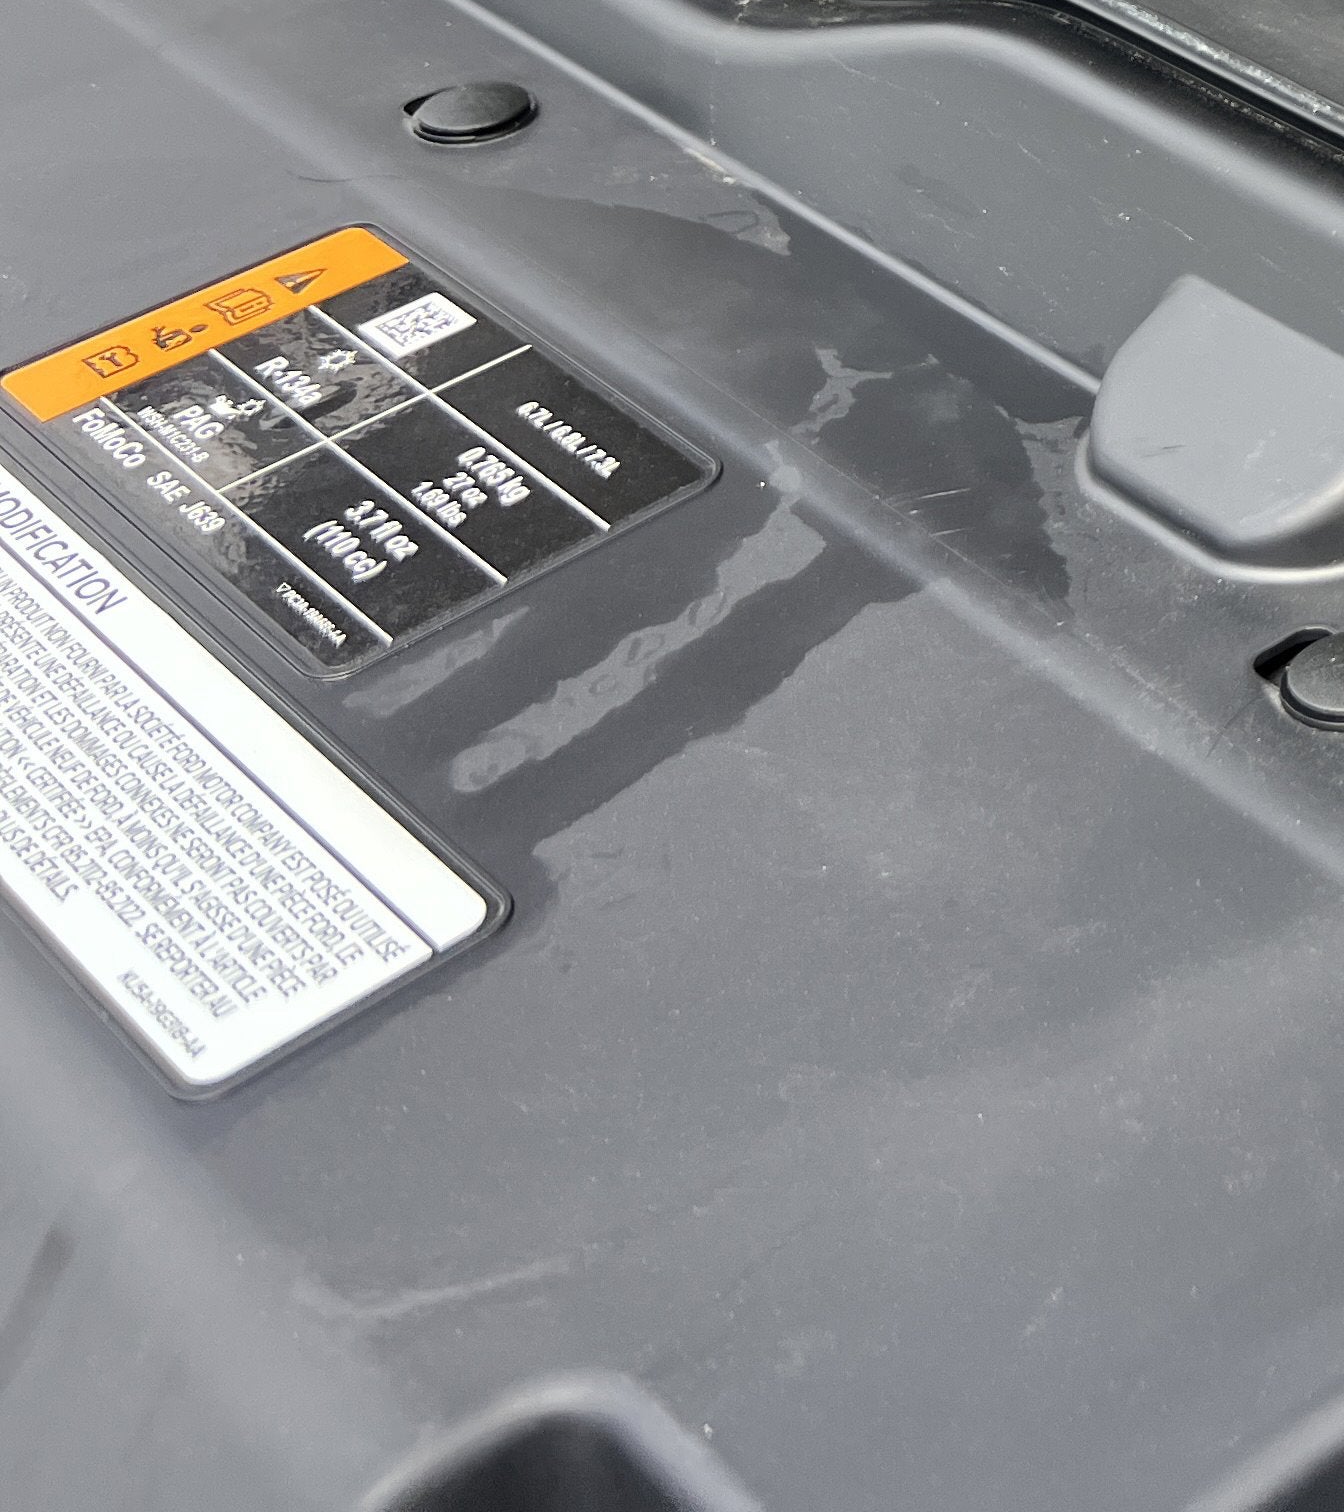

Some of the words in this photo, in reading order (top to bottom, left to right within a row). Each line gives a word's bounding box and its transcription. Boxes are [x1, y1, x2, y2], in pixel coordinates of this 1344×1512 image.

[256, 357, 322, 406] R-134a
[172, 405, 224, 440] PAG
[73, 409, 145, 468] FoMoCo
[147, 471, 190, 502] SAE
[179, 502, 225, 533] J639
[443, 472, 475, 491] 27
[461, 487, 487, 507] oz
[458, 447, 514, 486] 0.765
[497, 476, 530, 506] kg
[411, 481, 450, 509] 1.69
[436, 501, 466, 527] lbs
[0, 491, 126, 613] ODIFICATION
[304, 521, 360, 557] (110
[343, 551, 387, 582] cc)
[345, 500, 388, 528] 3.7
[384, 535, 418, 560] oz
[0, 645, 45, 696] ARATION
[30, 689, 59, 708] ET
[42, 702, 75, 726] LES
[3, 701, 60, 751] VÉHICULE
[60, 719, 128, 778] DOMMAGES
[3, 587, 55, 627] PRODUIT
[41, 622, 74, 649] NON
[61, 642, 109, 680] FOURNI
[94, 673, 128, 699] PAR
[113, 692, 140, 712] LA
[127, 705, 184, 749] SOCIÉTÉ
[166, 742, 207, 774] FORD
[193, 767, 244, 809] MOTOR
[231, 803, 295, 856] COMPANY
[280, 850, 317, 876] EST
[302, 870, 350, 906] POSÉ
[331, 898, 364, 922] OU
[33, 653, 67, 679] UNE
[52, 672, 126, 736] DÉFAILLANCE
[112, 730, 141, 750] OU
[127, 744, 174, 782] CAUSE
[158, 774, 186, 795] LA
[172, 788, 253, 859] DÉFAILLANCE
[238, 851, 286, 891] D'UNE
[44, 744, 86, 774] NEUF
[69, 769, 99, 791] DE
[83, 783, 124, 820] FORD,
[114, 772, 180, 829] CONNEXES
[9, 836, 40, 858] DE
[26, 766, 86, 819] CERTIFIÉE
[108, 849, 205, 937] CONFORMÉMENT
[122, 820, 168, 859] MOINS
[165, 821, 195, 844] NE
[0, 767, 56, 831] ÈGLEMENTS
[41, 825, 75, 851] CFR
[134, 922, 165, 945] SE
[150, 937, 219, 1001] REPORTER
[180, 837, 237, 882] SERONT
[221, 876, 258, 905] PAS
[244, 899, 314, 961] COUVERTS
[300, 953, 338, 985] PAR
